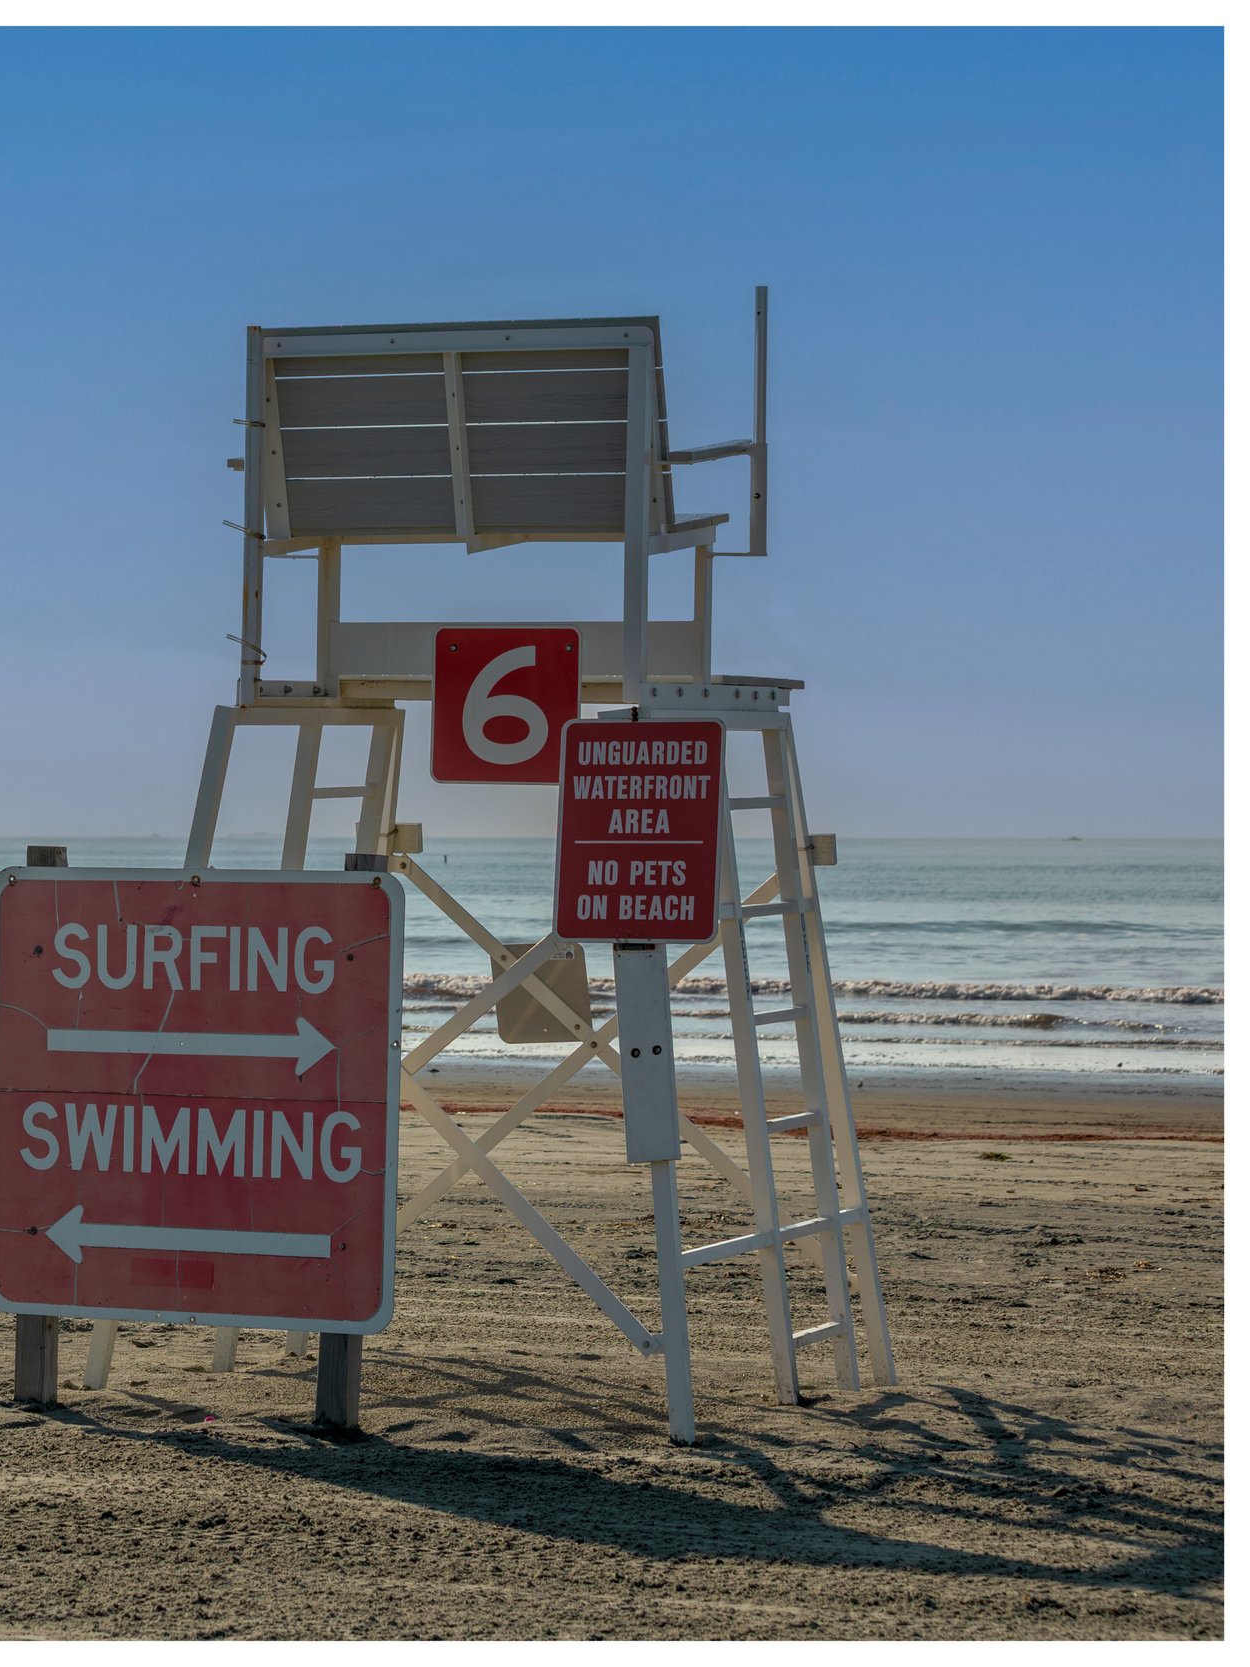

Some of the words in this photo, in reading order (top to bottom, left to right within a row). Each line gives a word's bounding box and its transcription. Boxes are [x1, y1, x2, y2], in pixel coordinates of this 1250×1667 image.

[462, 645, 549, 765] 6
[578, 740, 708, 766] UNGUARDED
[573, 775, 711, 800] WATERFRONT
[608, 809, 670, 834] AREA
[587, 860, 619, 886] NO
[630, 860, 687, 886] PETS
[577, 895, 608, 921] ON
[618, 895, 695, 921] BEACH
[51, 922, 335, 995] SURFING
[19, 1101, 363, 1184] SWIMMING
